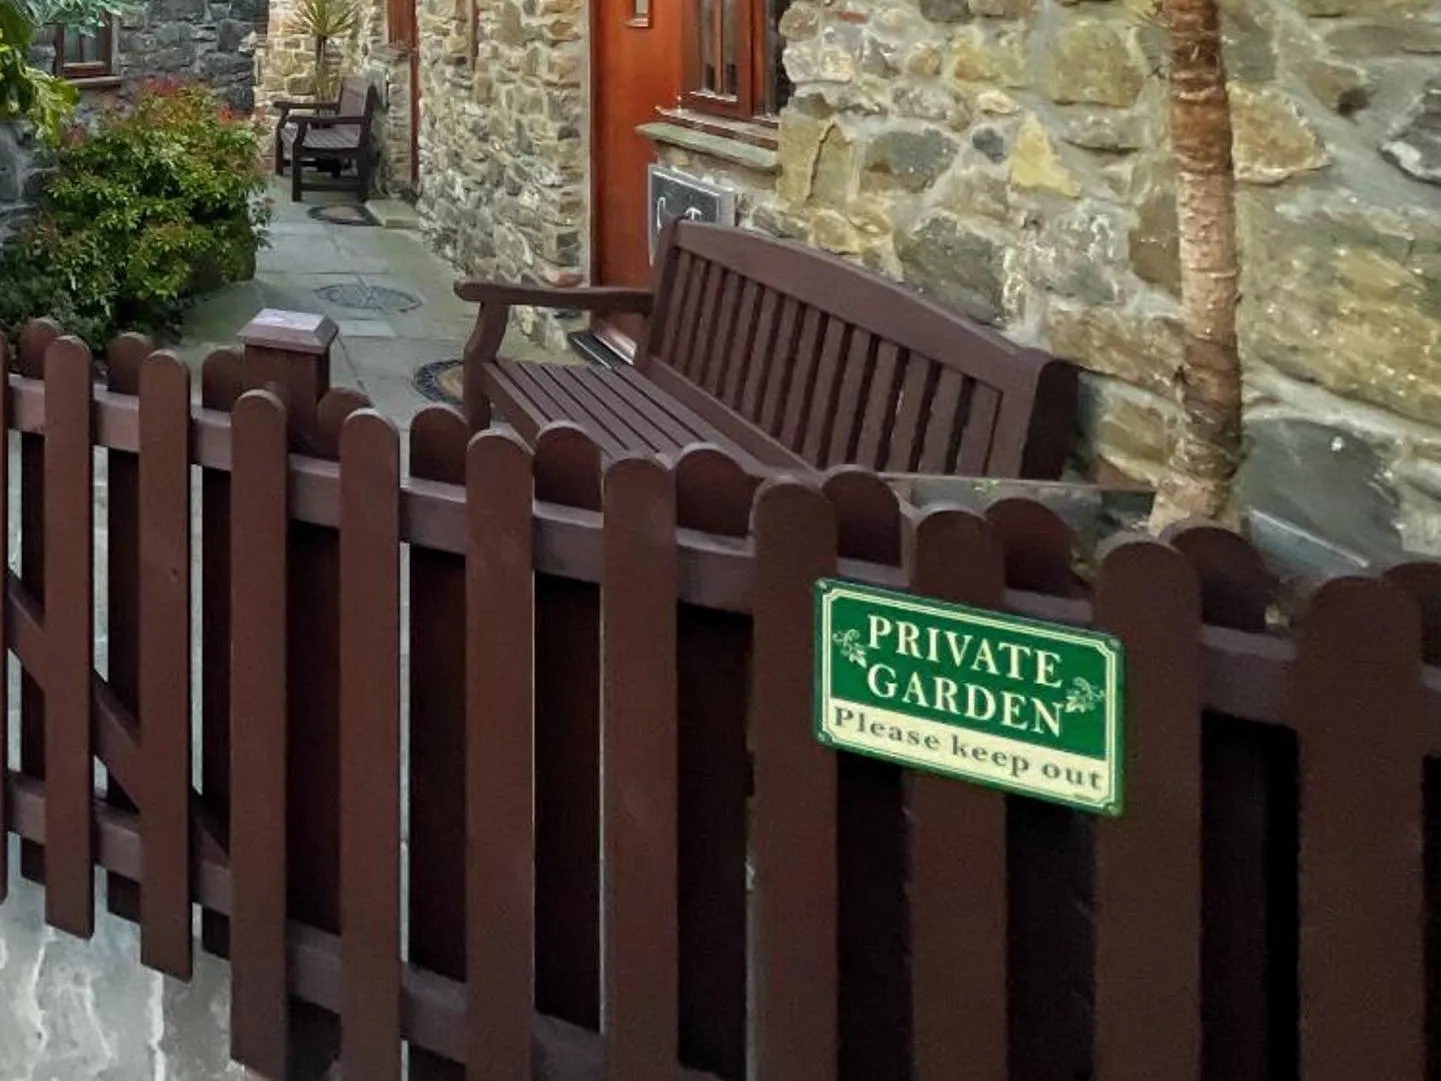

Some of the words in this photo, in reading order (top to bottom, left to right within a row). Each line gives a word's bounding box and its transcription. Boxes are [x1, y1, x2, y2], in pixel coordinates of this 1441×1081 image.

[867, 614, 1063, 688] PRIVATE
[867, 663, 1064, 738] GARDEN
[833, 706, 941, 751] Please
[951, 736, 1030, 778] keep
[1042, 763, 1103, 791] out
